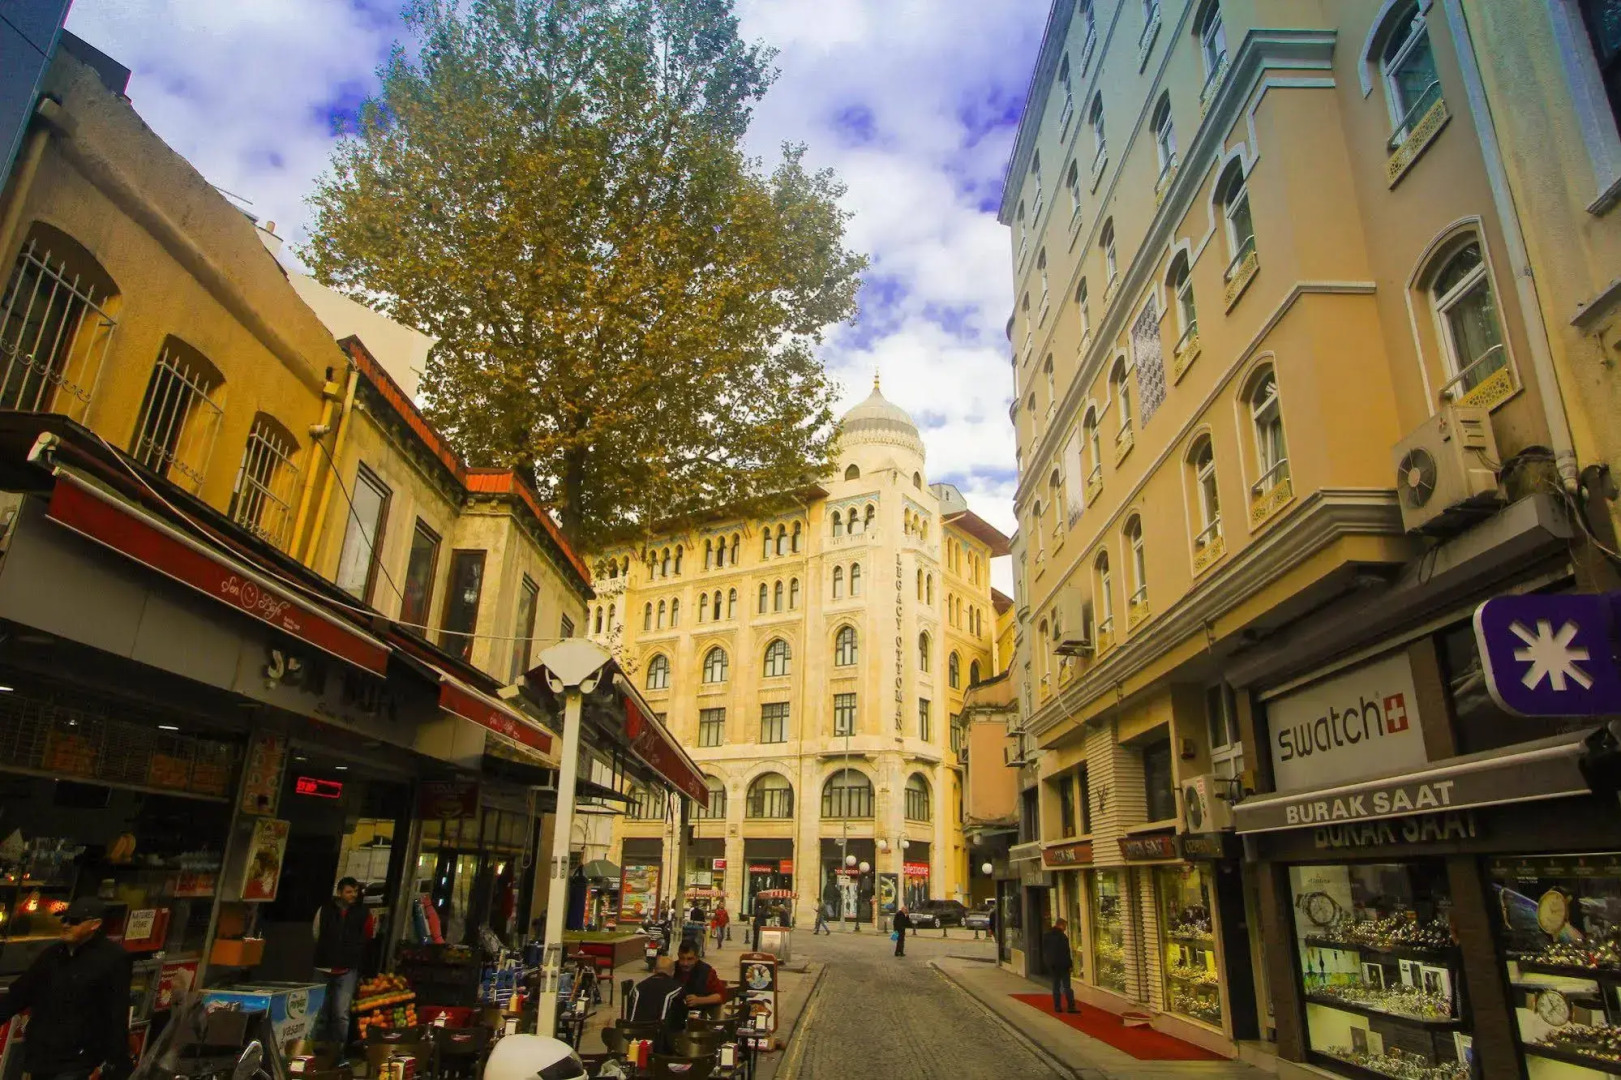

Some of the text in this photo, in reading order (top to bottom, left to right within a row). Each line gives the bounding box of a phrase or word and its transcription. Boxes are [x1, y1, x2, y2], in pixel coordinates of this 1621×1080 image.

[1278, 696, 1384, 762] swatch
[1286, 780, 1455, 825] BURAK SAAT
[903, 863, 928, 875] ollezione
